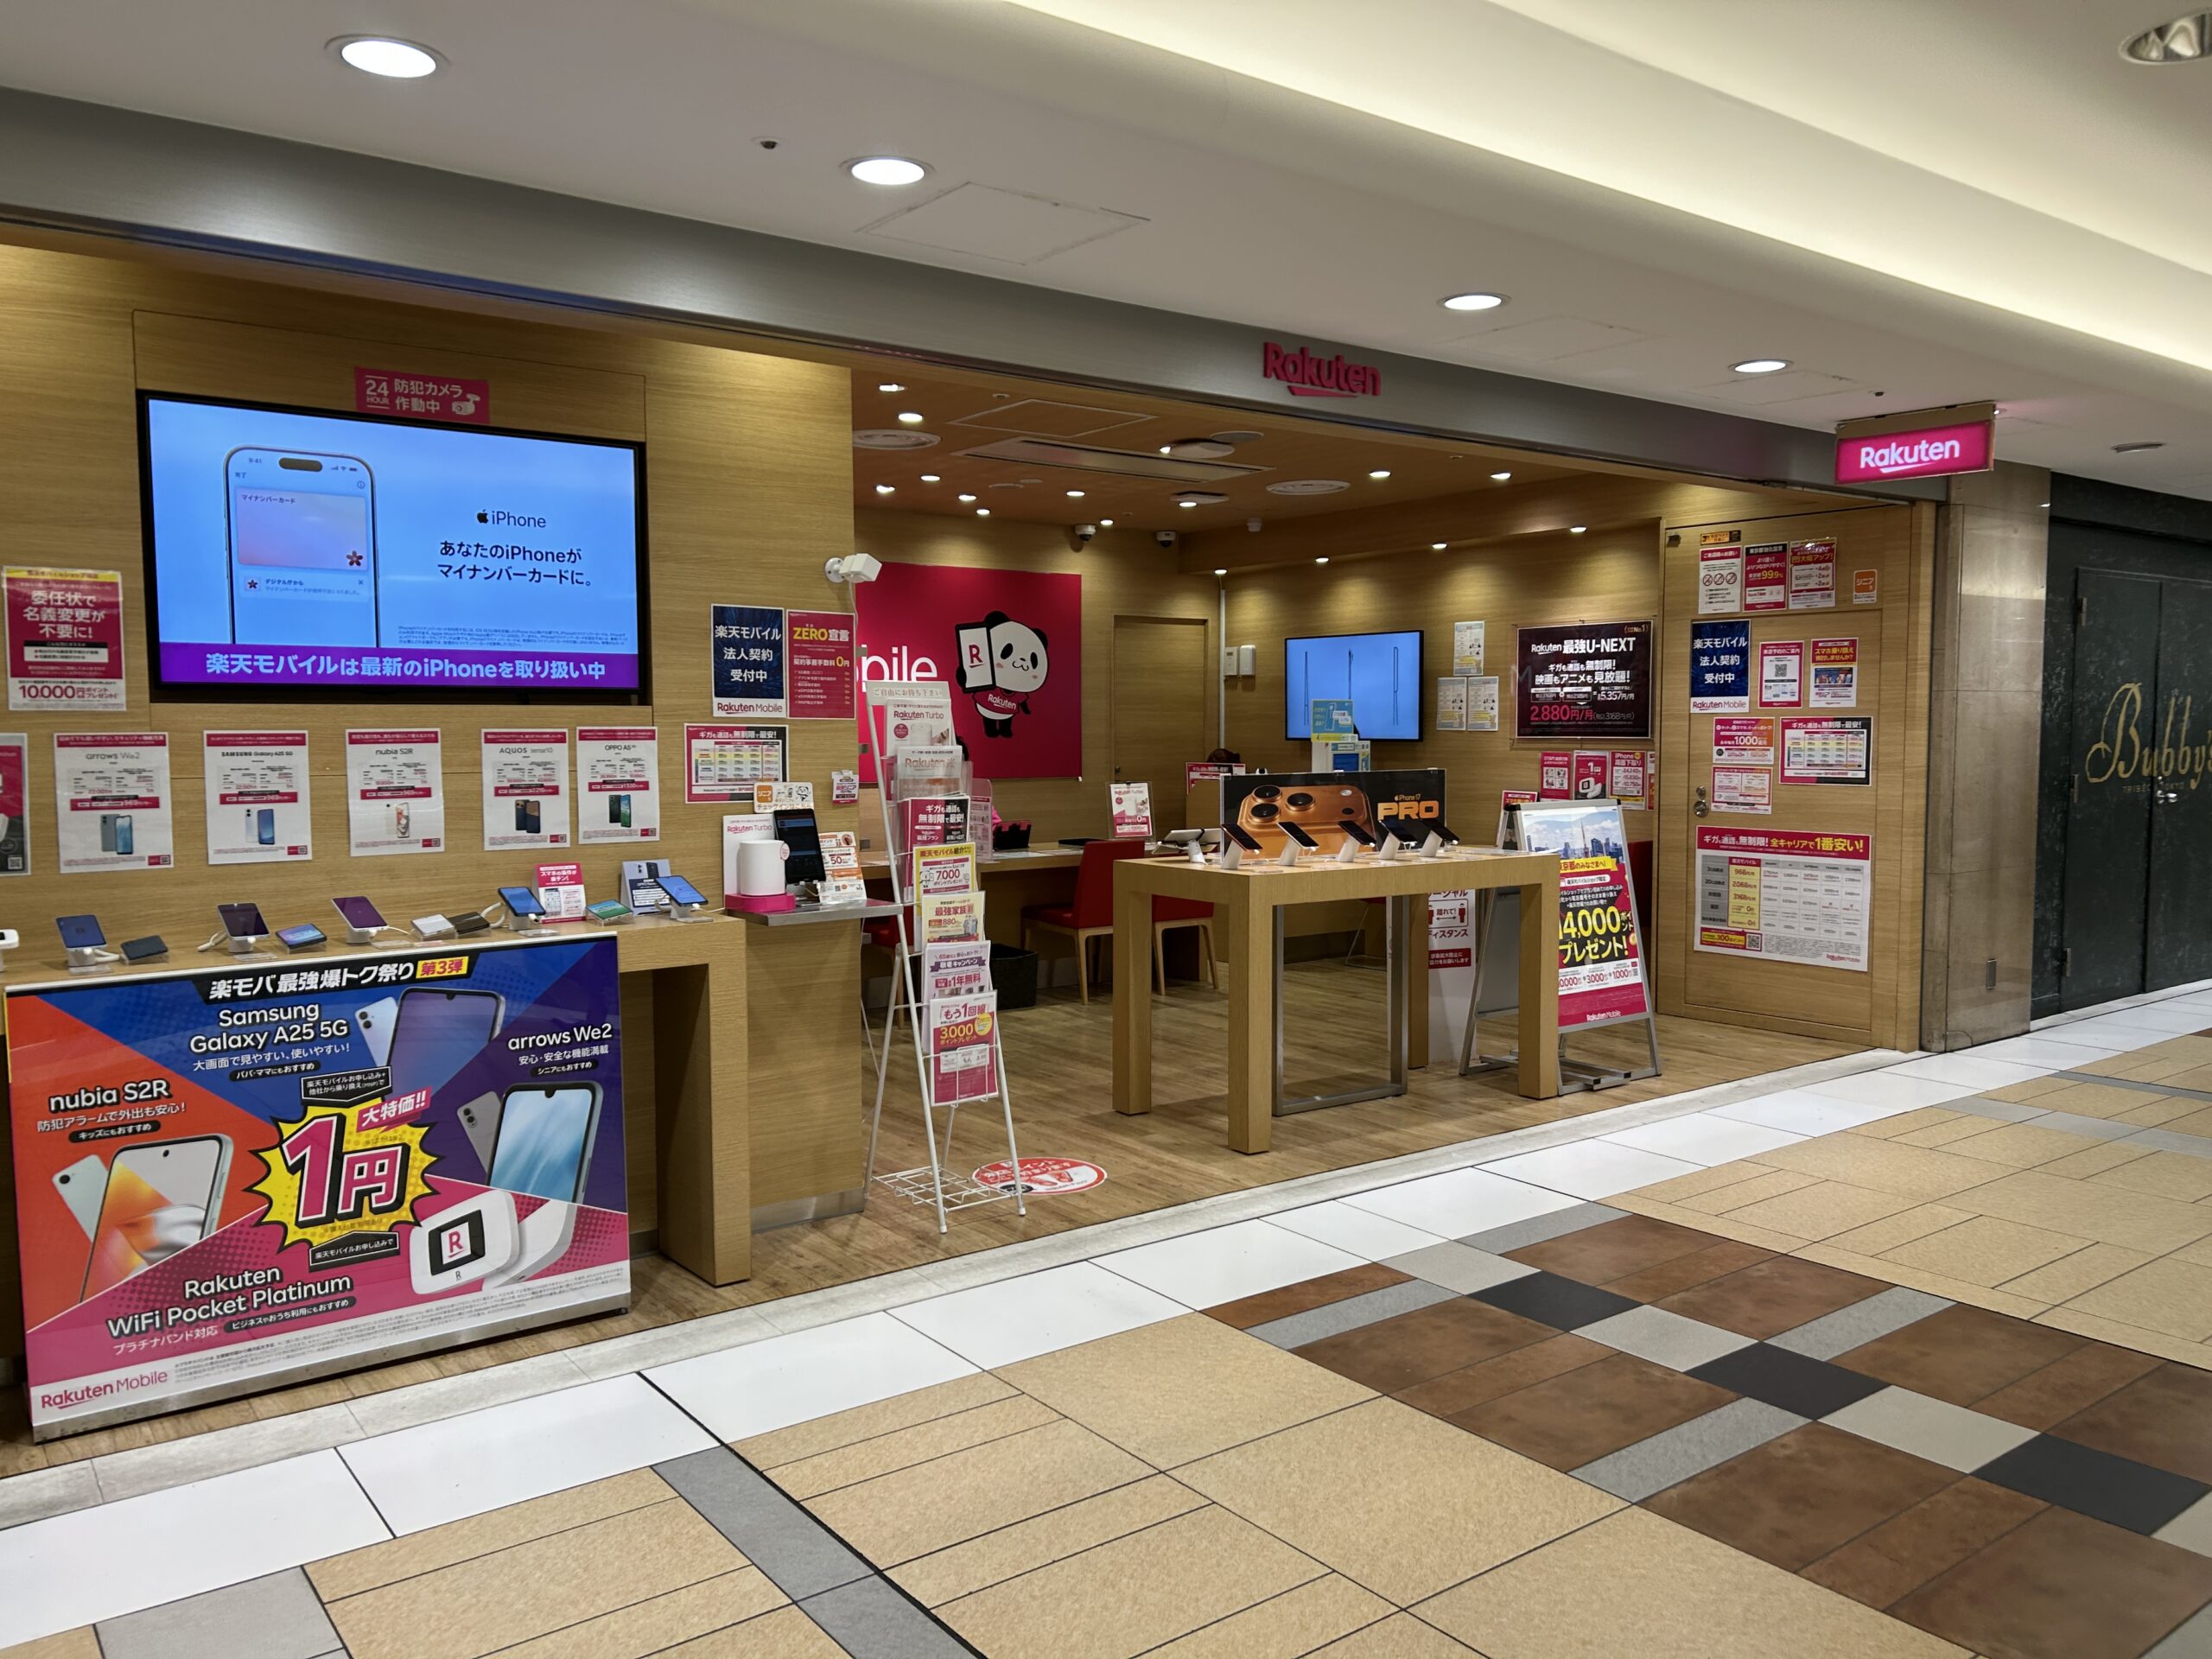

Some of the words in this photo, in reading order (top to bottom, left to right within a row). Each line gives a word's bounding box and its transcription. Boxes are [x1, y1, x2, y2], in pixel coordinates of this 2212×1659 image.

[1263, 341, 1381, 397] Rakuten
[365, 380, 389, 397] 24
[394, 378, 463, 398] 防犯カメラ
[366, 396, 389, 405] HOUR
[395, 396, 441, 413] 作動中
[1859, 439, 1961, 473] Rakuten
[242, 493, 296, 504] マイナンバーカード
[491, 510, 546, 528] iPhone
[439, 540, 582, 563] あなたのiPhoneが
[437, 563, 591, 587] マイナンバーカードに。
[31, 590, 97, 607] 委任状で
[23, 607, 105, 622] 名義変更が
[39, 624, 92, 639] 不要に!
[715, 625, 781, 641] 楽天モバイル
[793, 627, 850, 641] ZERO宣言
[1531, 644, 1562, 655] Rakuten
[1563, 638, 1636, 654] 最強U-NEXT
[1693, 637, 1747, 649] 楽天モバイル
[723, 647, 773, 662] 法人契約
[969, 645, 983, 664] R
[1700, 655, 1740, 666] 法人契約
[206, 652, 606, 680] 楽天モバイルは最新のiPhoneを取り扱い中
[856, 645, 938, 692] bile
[1548, 660, 1616, 672] ギガも通話も無制限!
[730, 669, 767, 683] 受付中
[1535, 671, 1630, 684] 映画もアニメも見放題!
[1704, 672, 1735, 684] 受付中
[717, 702, 754, 715] Rakuten
[755, 703, 783, 713] Mobile
[988, 694, 1017, 710] Rakuten
[1693, 701, 1723, 711] Rakuten
[1724, 700, 1746, 709] Mobile
[893, 710, 925, 721] Rakuten
[906, 758, 945, 770] Rakuten
[945, 759, 956, 768] 光
[1377, 800, 1440, 820] PRO
[1770, 836, 1864, 854] 全キャリアで1番安い!
[1559, 935, 1629, 964] プレゼント!
[210, 962, 414, 1000] 楽モバ最強爆トク祭り
[421, 958, 463, 976] 第3弾
[219, 1002, 320, 1027] Samsung
[190, 1030, 266, 1054] Galaxy
[273, 1025, 315, 1044] A25
[321, 1020, 347, 1038] 5G
[508, 1029, 571, 1050] arrows
[573, 1023, 612, 1041] We2
[193, 1043, 350, 1071] 大画面で見やすい、使いやすい!
[518, 1045, 609, 1065] 安心・安全な機能満載
[235, 1062, 315, 1079] パパ・ママにもおすすめ
[538, 1061, 592, 1075] シニアにもおすすめ
[49, 1087, 117, 1111] nubia
[124, 1079, 169, 1102] S2R
[37, 1103, 186, 1132] 防犯アラームで外出も安心!
[362, 1093, 425, 1127] 大特価!!
[78, 1122, 152, 1140] キッズにもおすすめ
[282, 1115, 404, 1221] 1円
[315, 1238, 394, 1259] 楽天モバイルお申し込みで
[448, 1230, 465, 1252] R
[185, 1267, 280, 1299] Rakuten
[108, 1311, 162, 1338] WiFi
[168, 1295, 245, 1326] Pocket
[252, 1275, 351, 1306] Platinum
[112, 1325, 218, 1356] プラチナバンド対応
[232, 1299, 348, 1331] ビジネスやおうち利用にもおすすめ
[41, 1382, 113, 1409] Rakuten
[116, 1371, 168, 1394] Mobile
